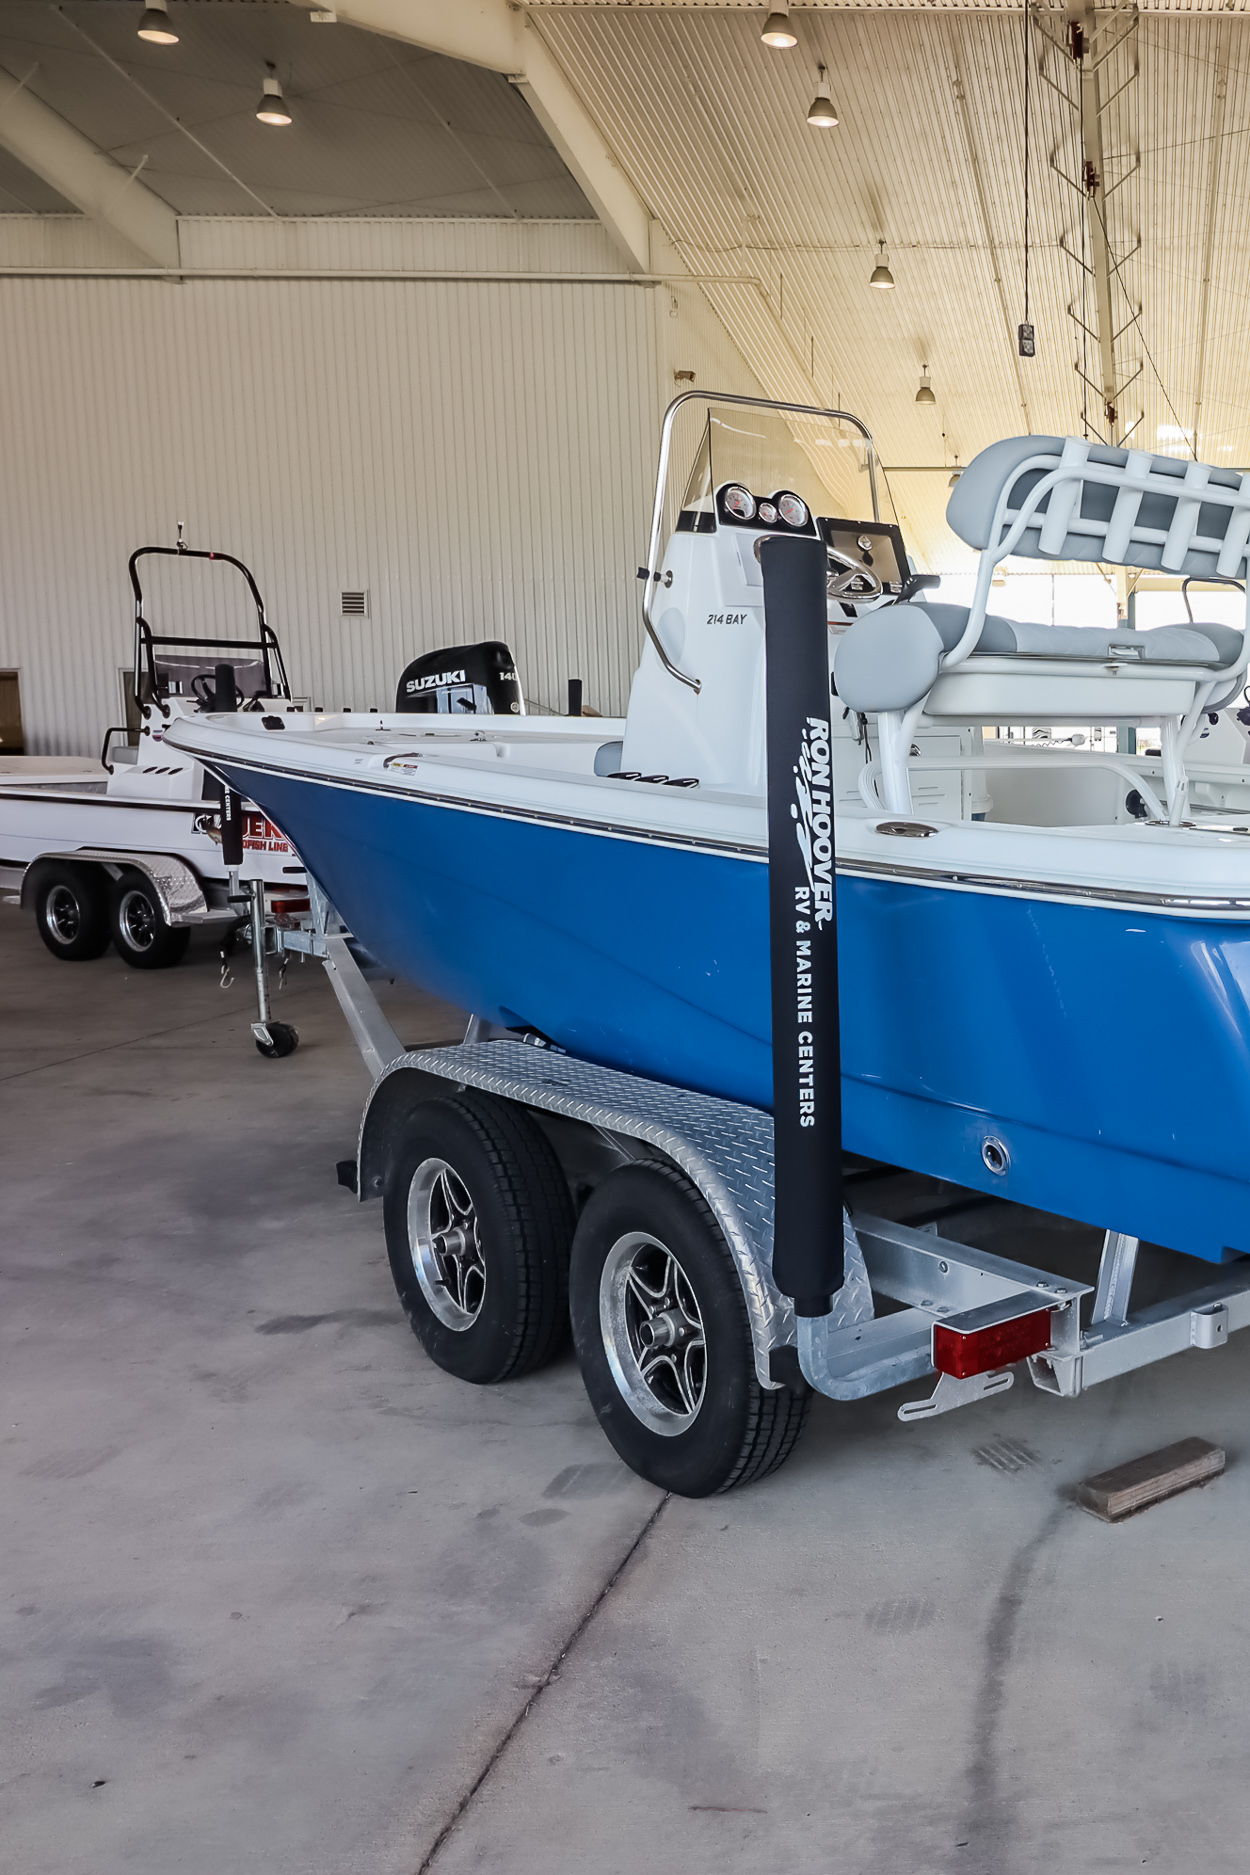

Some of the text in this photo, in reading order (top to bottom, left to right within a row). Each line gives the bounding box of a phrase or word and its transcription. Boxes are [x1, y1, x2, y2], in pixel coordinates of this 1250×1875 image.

[706, 614, 747, 625] 214 BAY
[405, 669, 466, 693] SUZUKI
[806, 717, 832, 930] RON HOOVER
[268, 844, 288, 852] LINE
[795, 886, 815, 1128] RV & MARINE CENTERS
